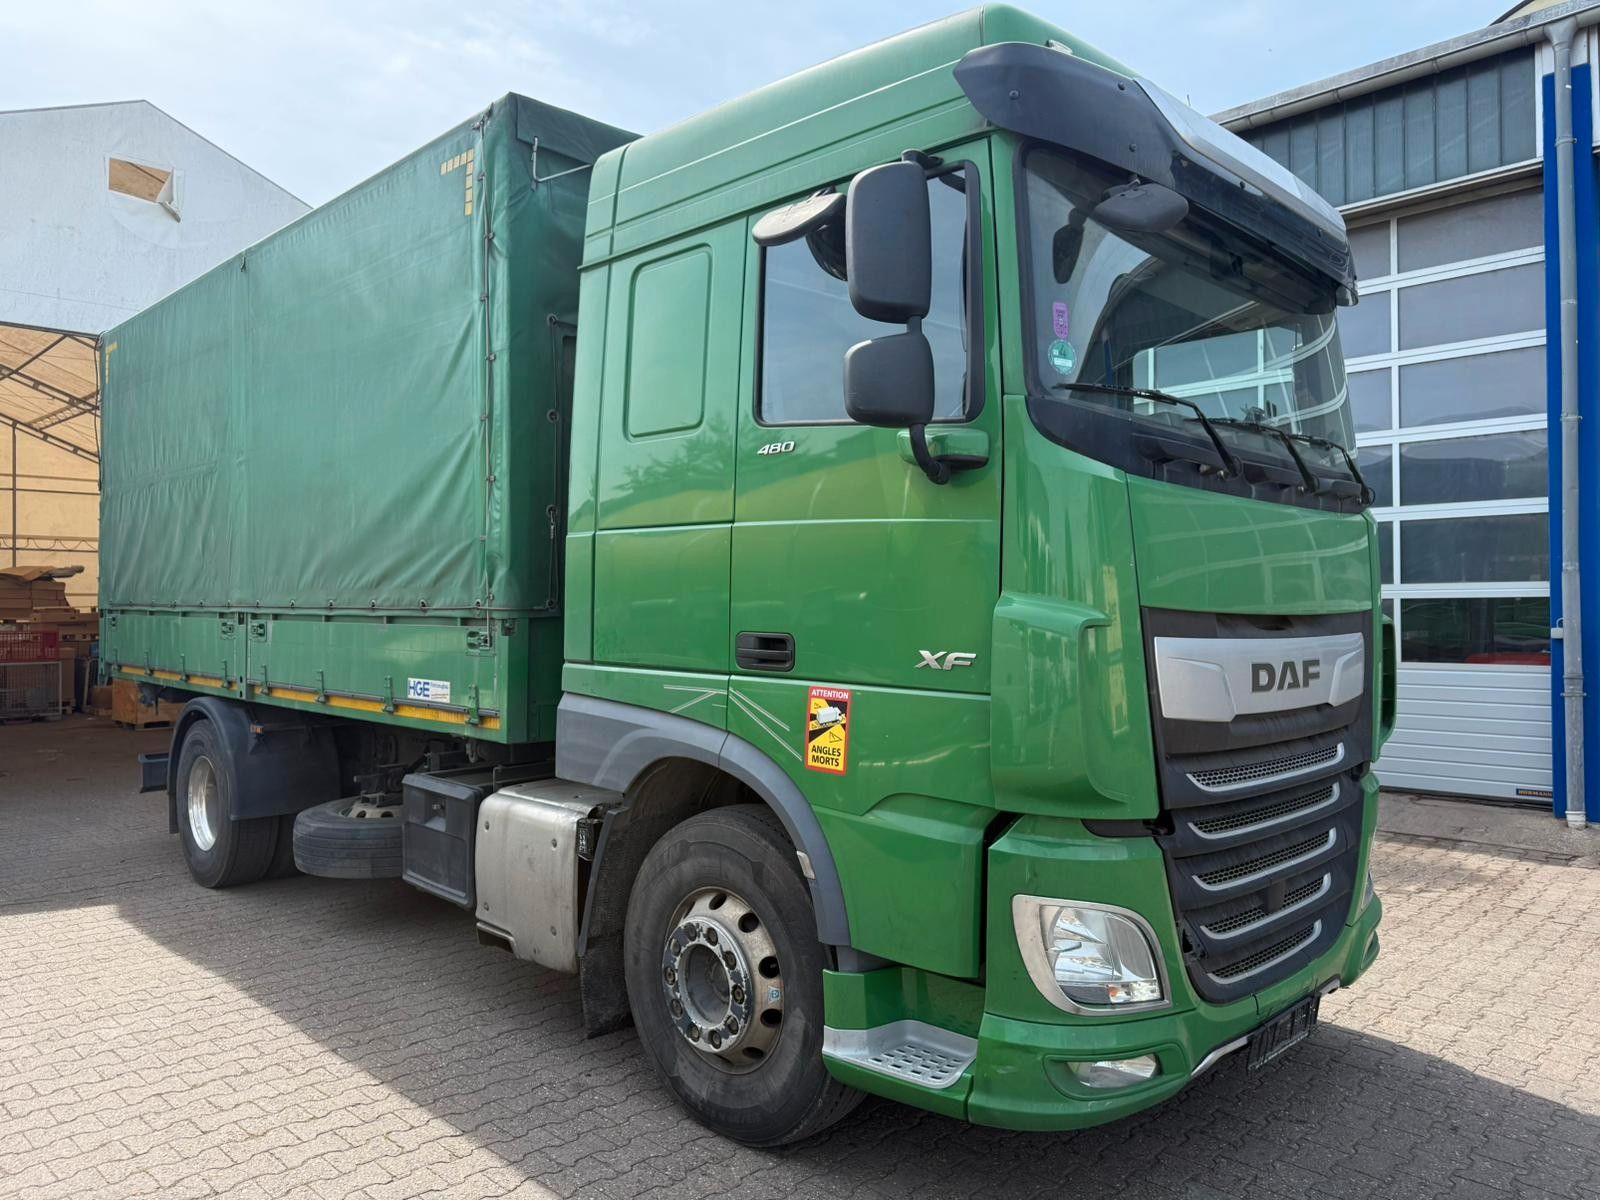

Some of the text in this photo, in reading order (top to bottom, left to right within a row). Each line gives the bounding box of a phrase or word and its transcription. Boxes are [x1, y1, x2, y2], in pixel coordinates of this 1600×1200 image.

[757, 441, 795, 455] 480
[915, 650, 977, 670] XF
[1251, 659, 1320, 692] DAF
[408, 680, 430, 698] HGE
[811, 688, 849, 699] ATTENTION
[811, 745, 842, 757] ANGLES
[811, 754, 840, 767] MORTS
